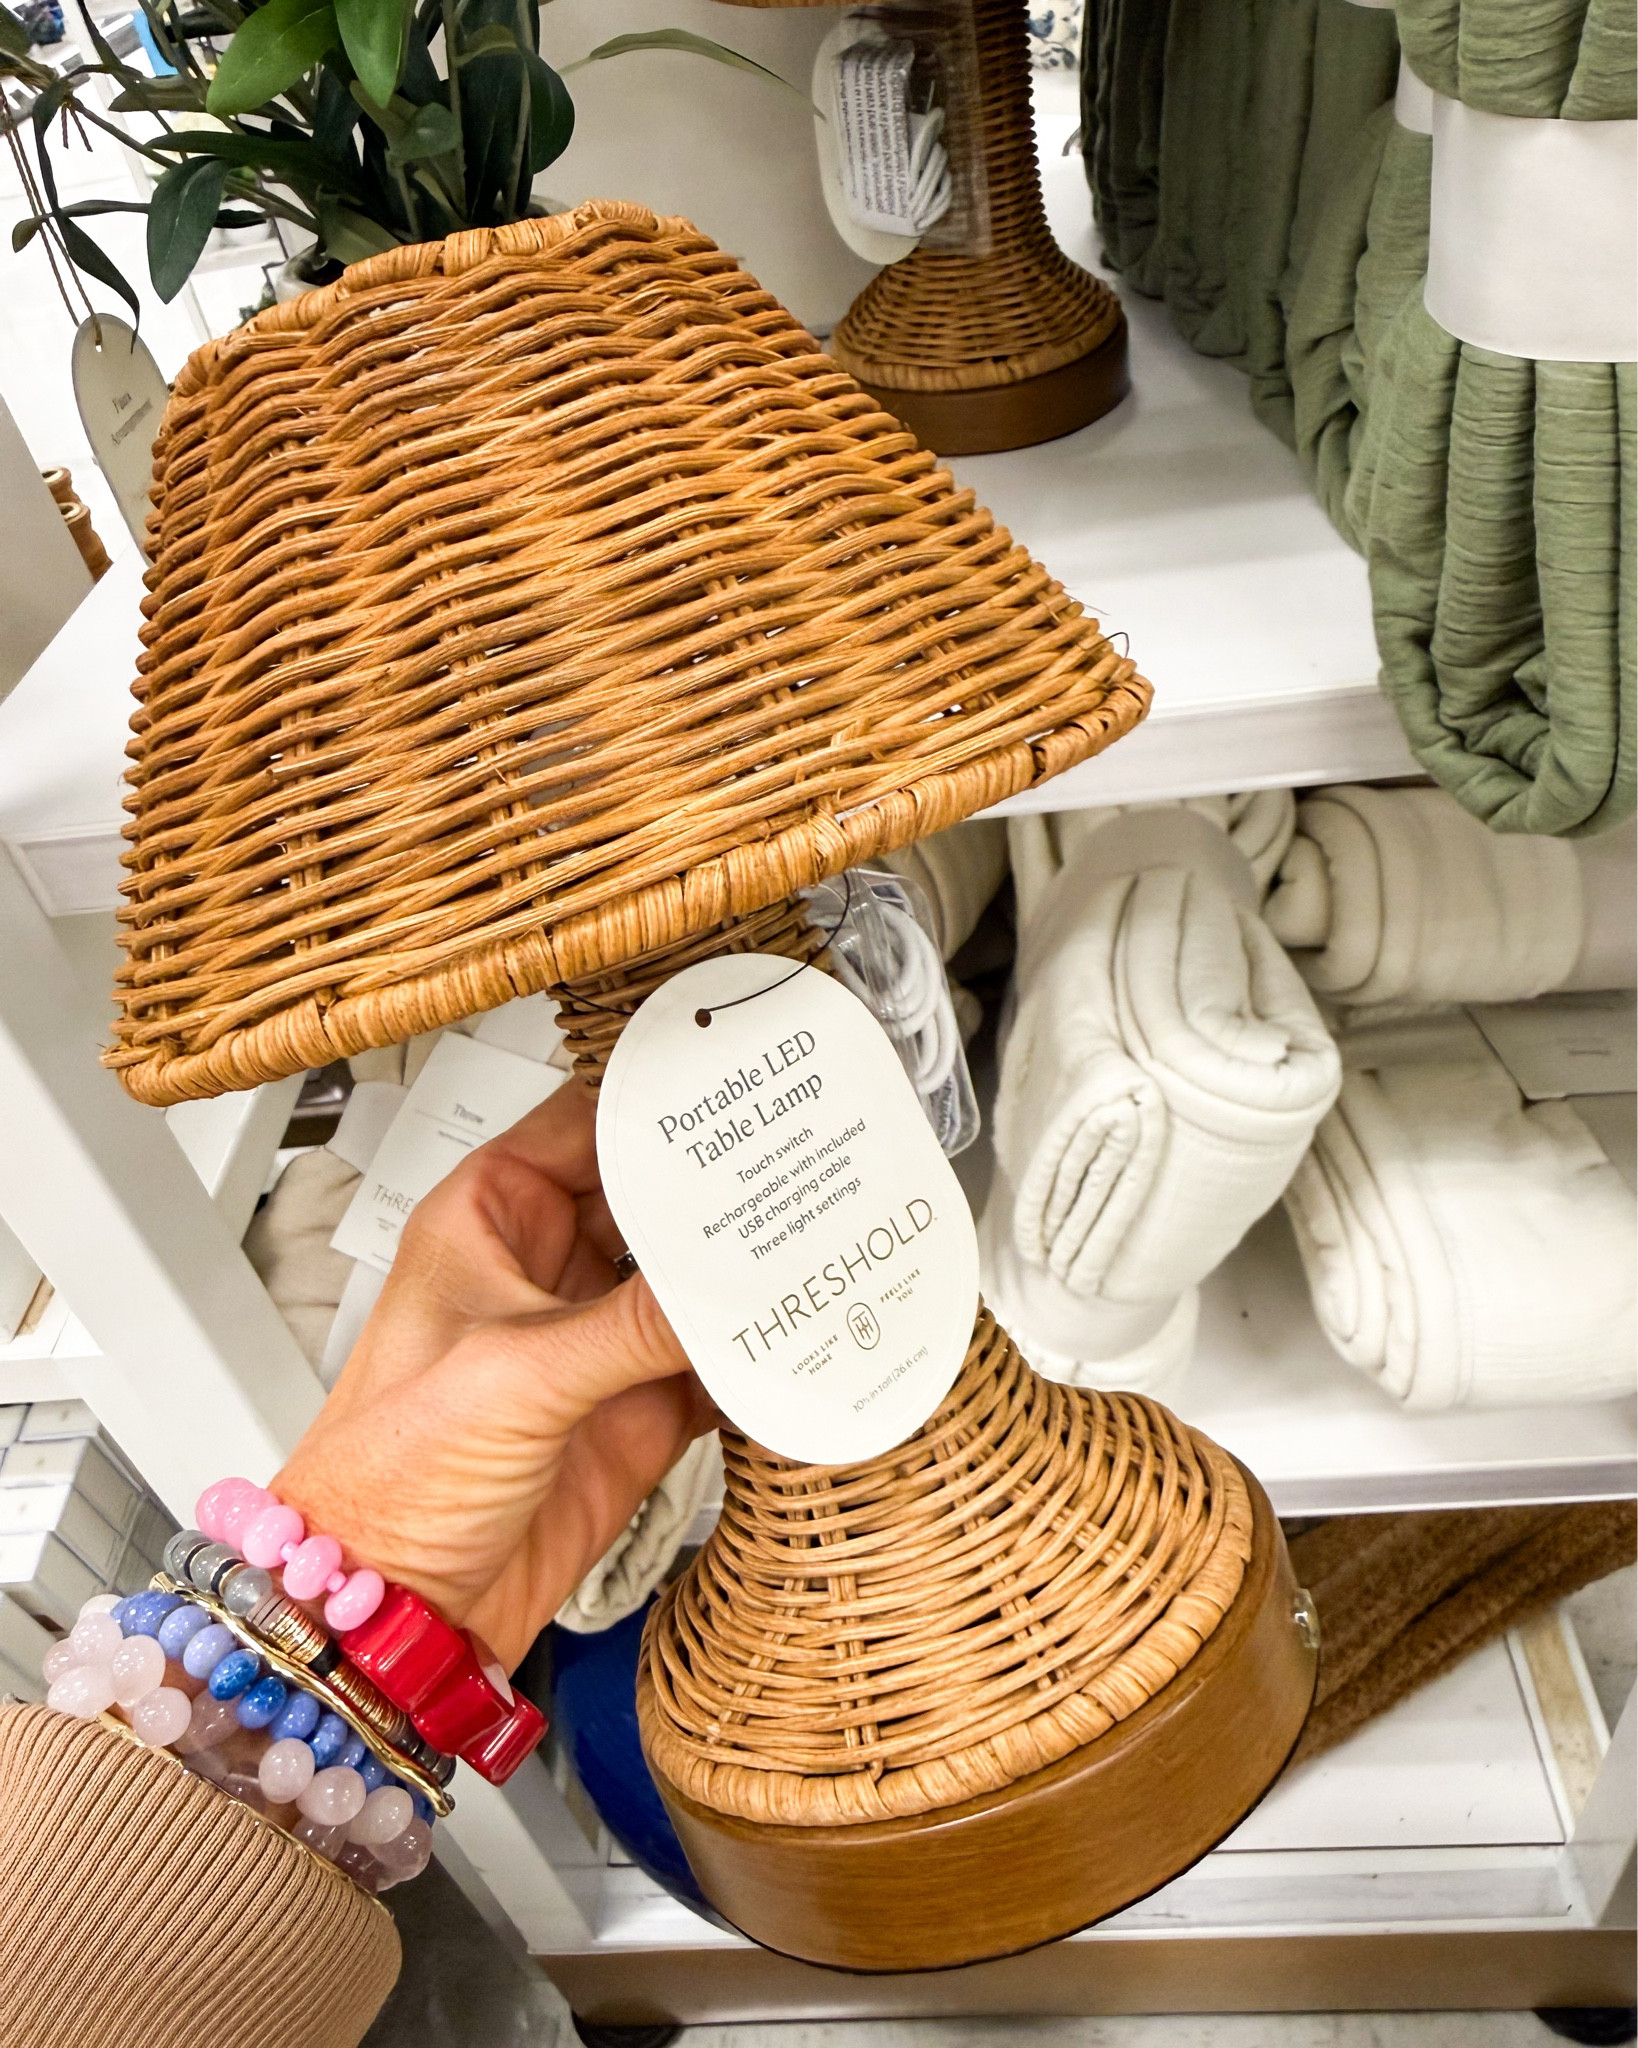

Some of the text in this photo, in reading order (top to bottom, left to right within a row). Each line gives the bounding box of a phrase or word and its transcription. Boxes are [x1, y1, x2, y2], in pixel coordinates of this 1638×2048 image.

[658, 1031, 816, 1144] Portable LED
[686, 1074, 822, 1168] Table Lamp
[703, 1118, 866, 1239] Rechargeable with included
[736, 1128, 814, 1183] Touch switch
[373, 1184, 414, 1214] THRE
[738, 1155, 852, 1239] USB charging cable
[751, 1178, 862, 1260] Three light settings
[732, 1198, 934, 1362] THRESHOLD
[880, 1268, 920, 1303] FEELS LIKE
[897, 1287, 913, 1302] YOU
[792, 1334, 838, 1375] LOOKS LIKE
[808, 1353, 832, 1375] HOME
